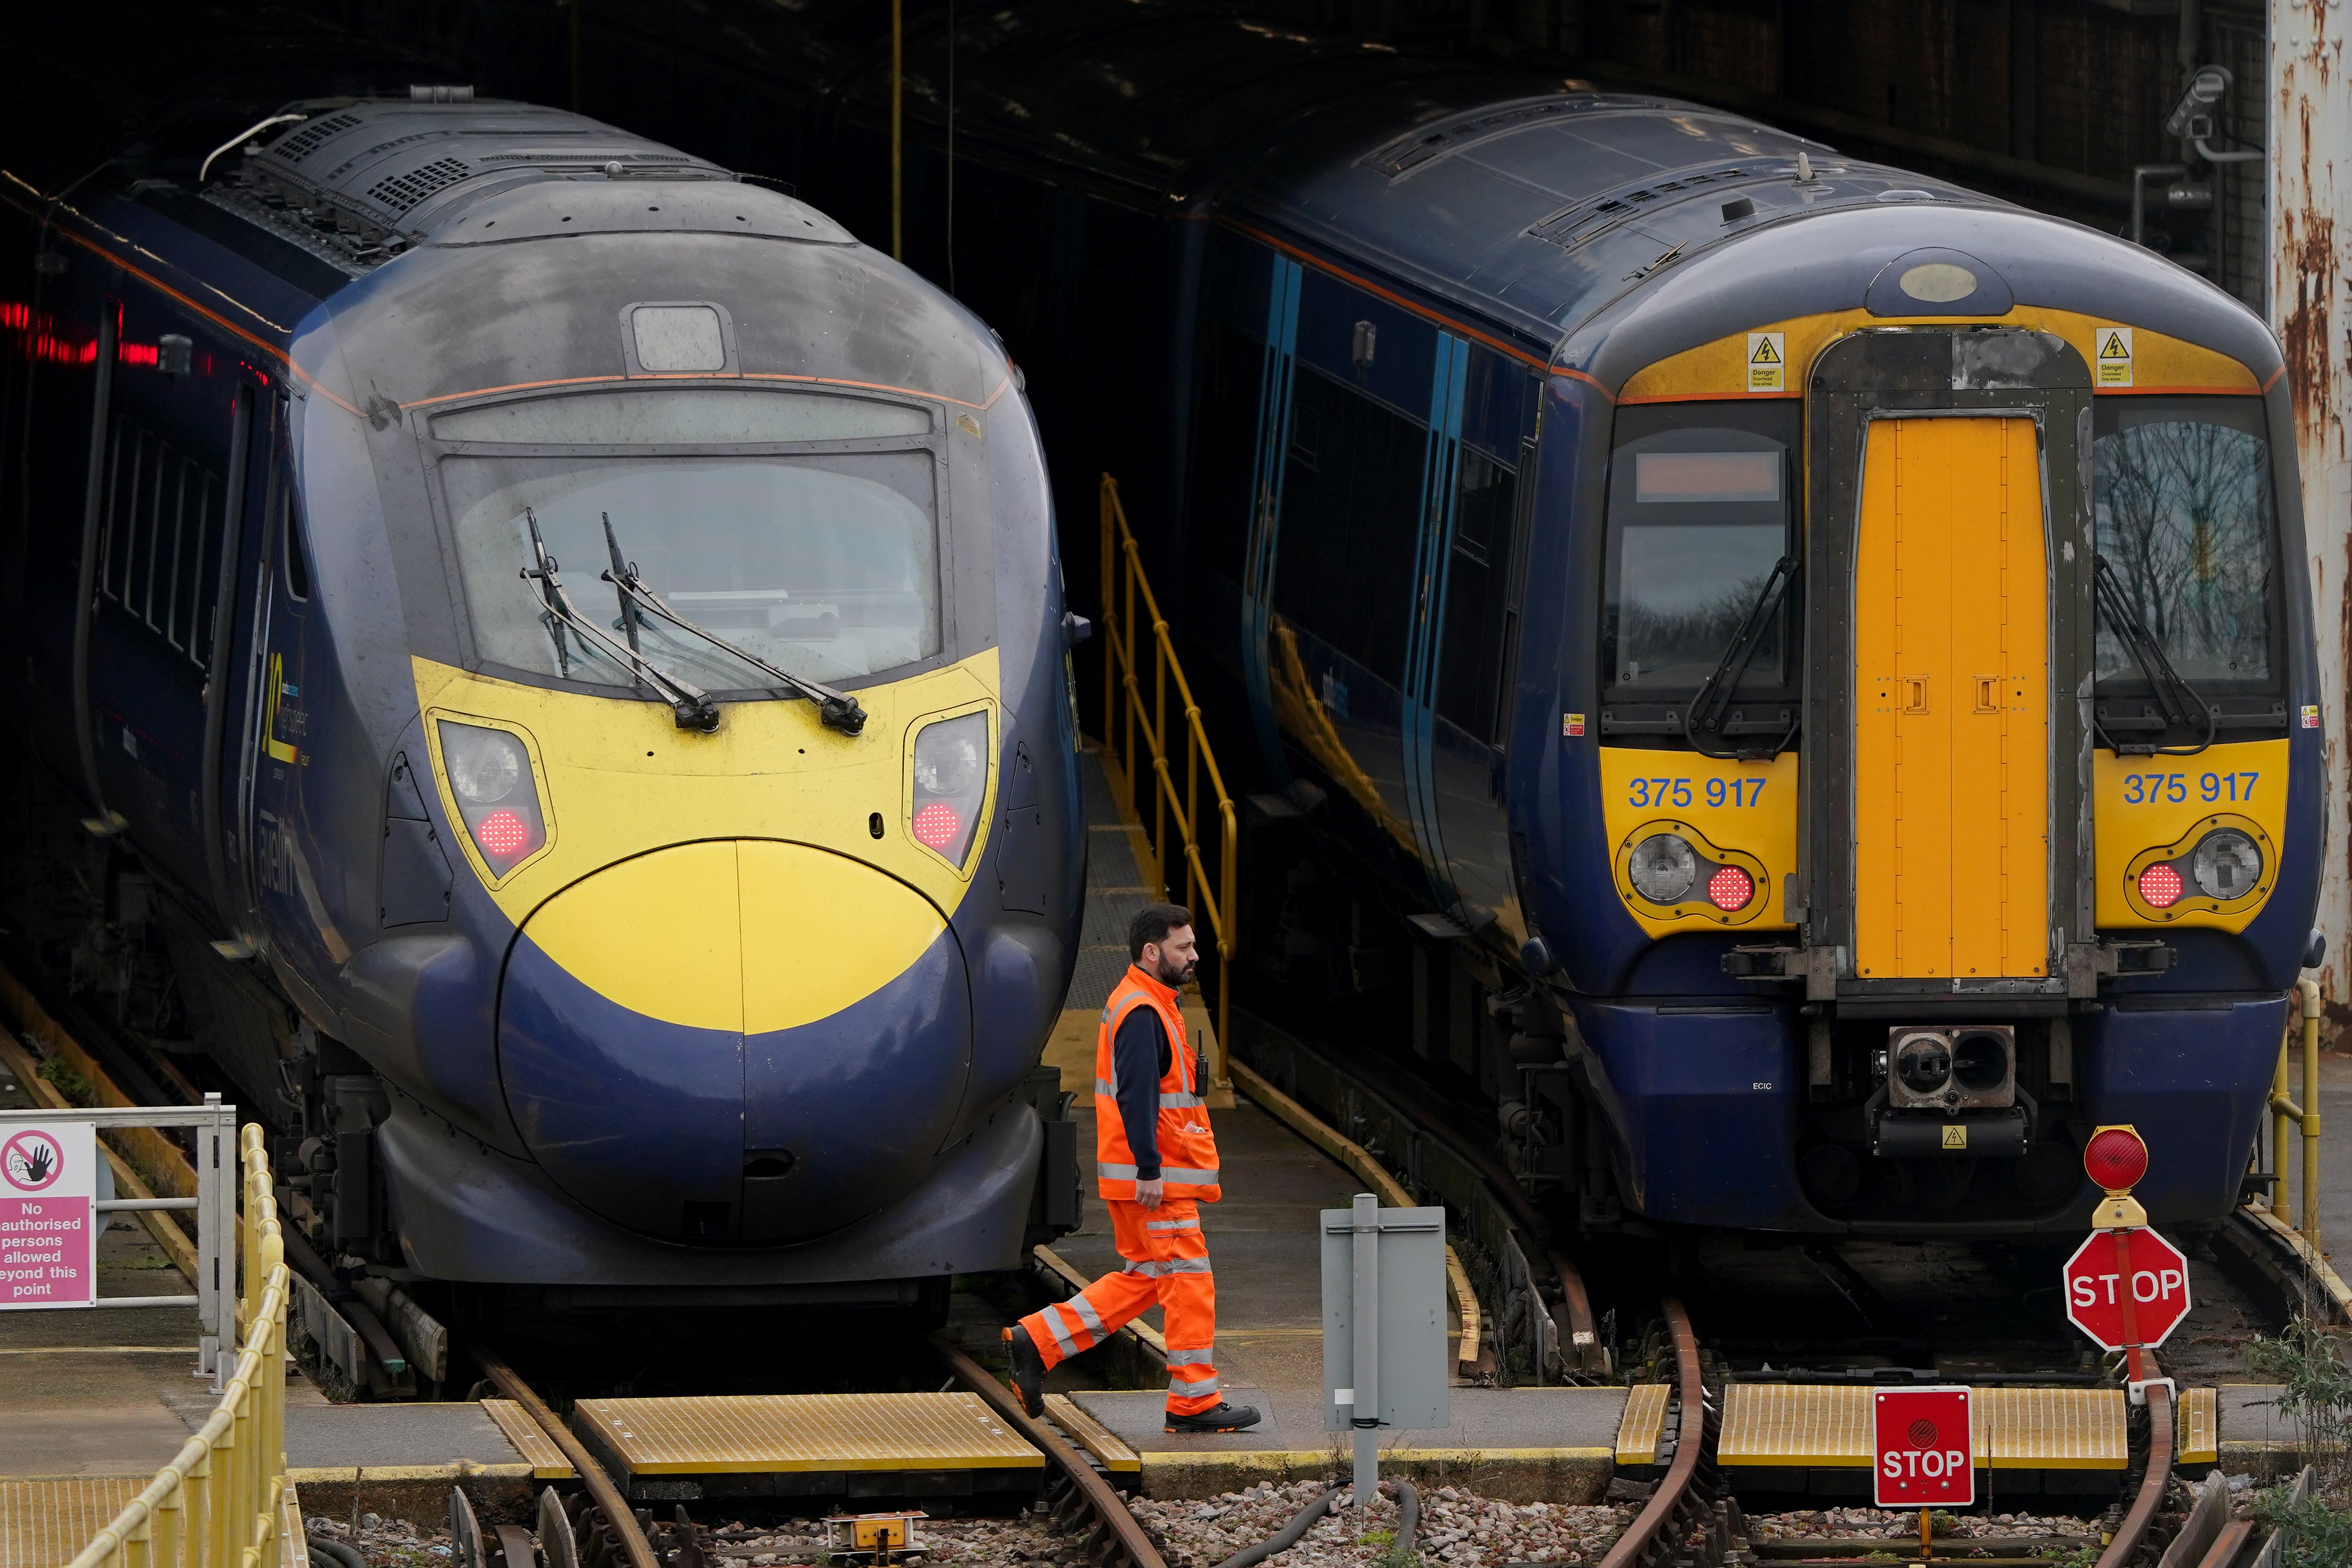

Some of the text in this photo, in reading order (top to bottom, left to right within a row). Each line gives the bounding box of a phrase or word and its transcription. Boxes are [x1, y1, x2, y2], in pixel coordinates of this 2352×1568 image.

[1629, 778, 1766, 807] 375 917
[2124, 772, 2259, 804] 375 917
[22, 1203, 43, 1215] No
[0, 1218, 81, 1231] authorised
[2, 1236, 63, 1250] persons
[4, 1250, 61, 1263] allowed
[0, 1266, 77, 1282] eyond this
[14, 1283, 51, 1298] point
[2073, 1269, 2182, 1307] STOP
[1883, 1450, 1964, 1478] STOP
